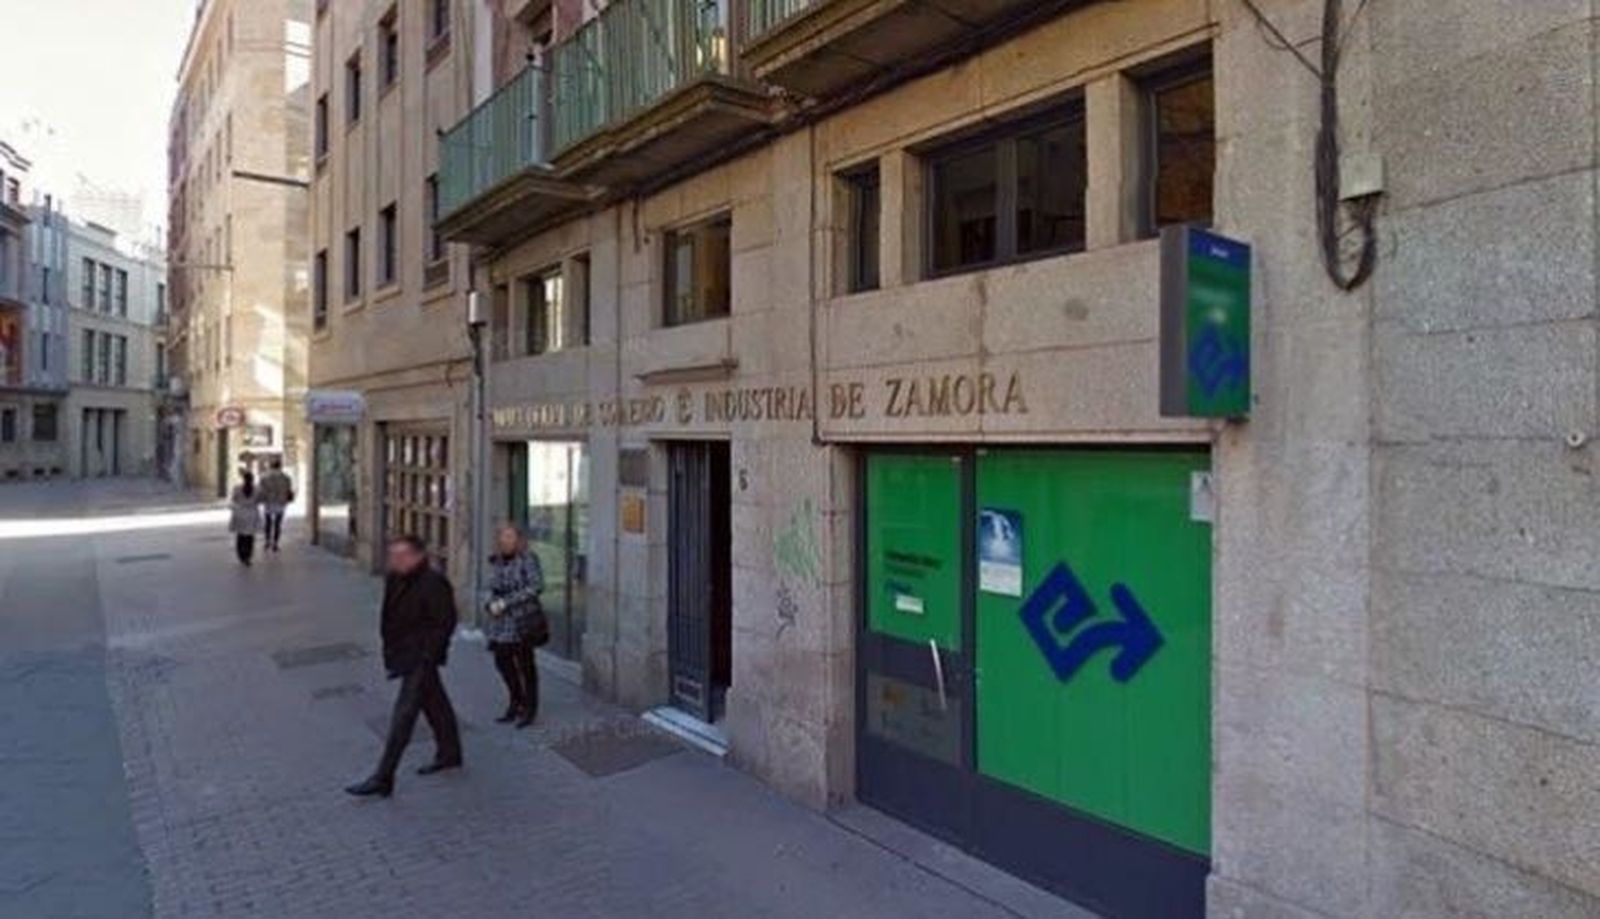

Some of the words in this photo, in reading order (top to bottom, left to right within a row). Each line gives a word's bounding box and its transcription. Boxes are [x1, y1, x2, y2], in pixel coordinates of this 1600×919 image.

[704, 386, 813, 422] INDUSTRIA
[829, 383, 865, 420] DE
[885, 371, 1029, 418] ZAMORA
